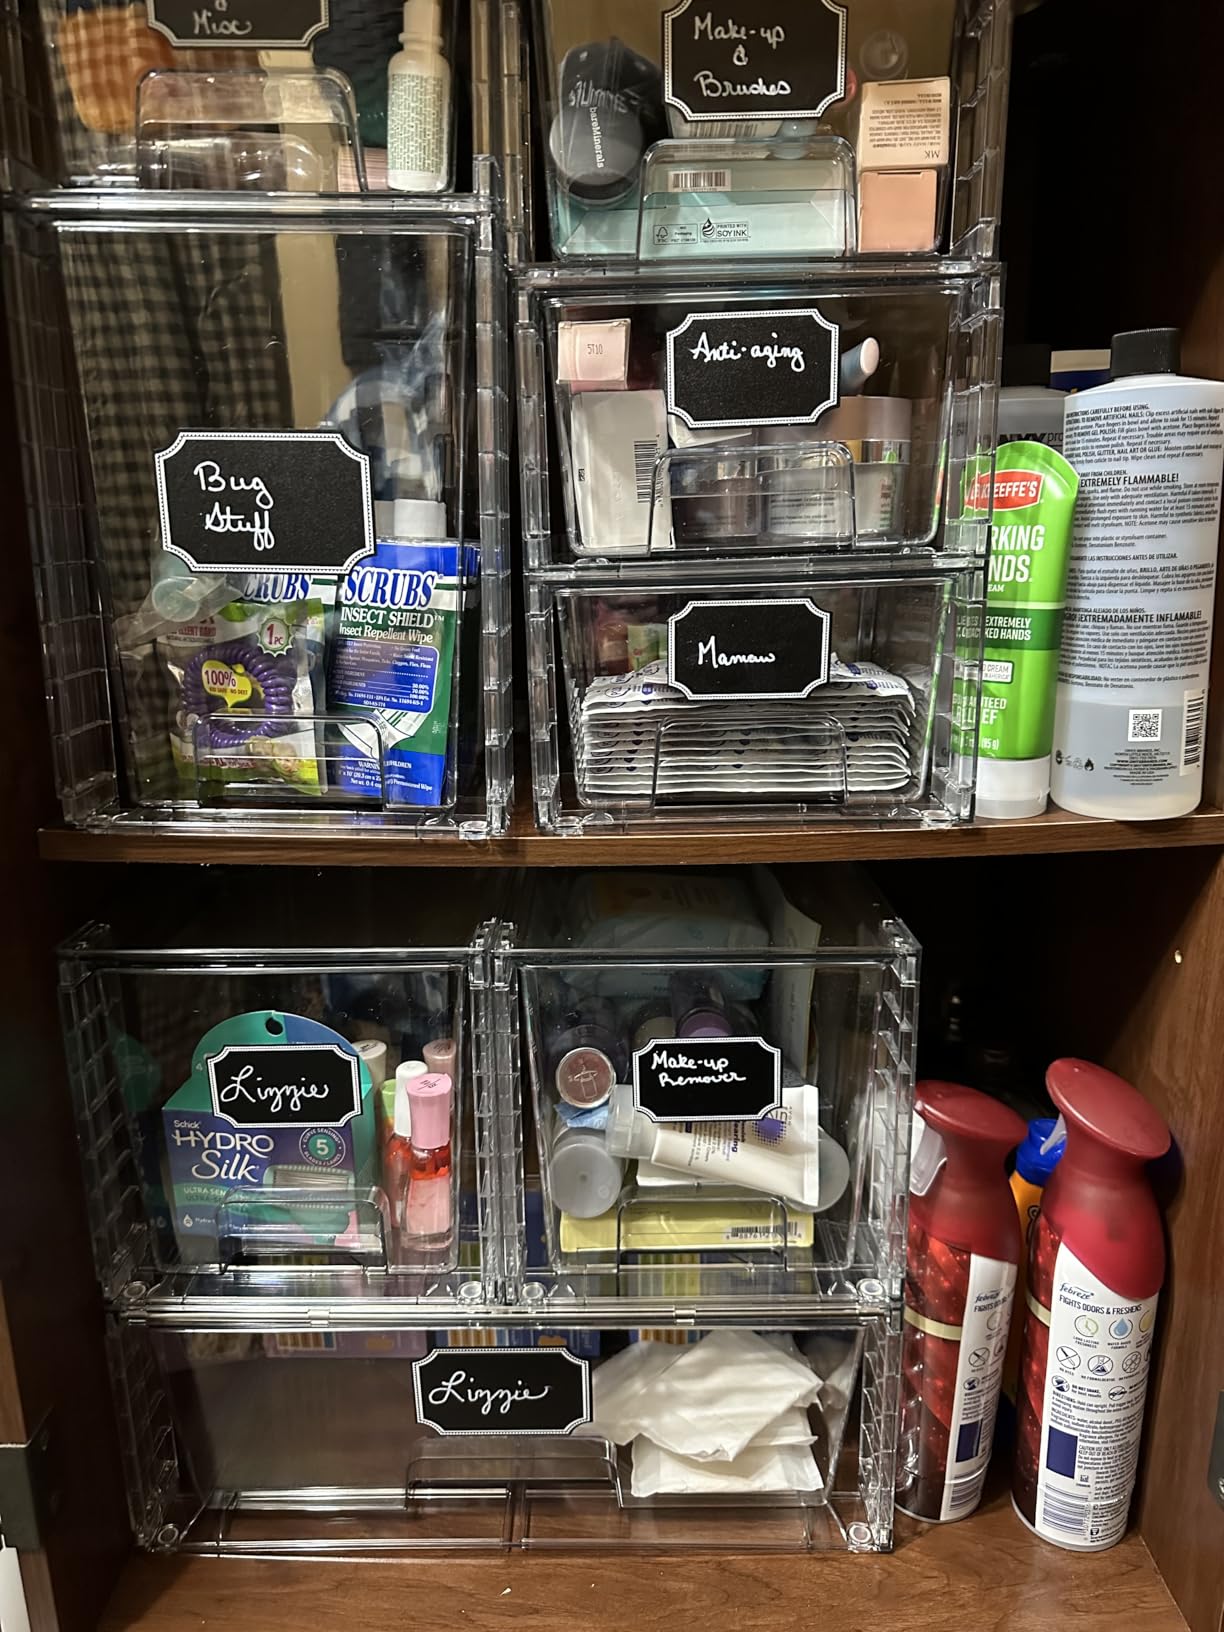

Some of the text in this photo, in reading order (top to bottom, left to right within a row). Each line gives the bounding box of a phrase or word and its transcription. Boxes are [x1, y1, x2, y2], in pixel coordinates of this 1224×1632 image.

[192, 8, 253, 36] Misc
[693, 11, 785, 50] Make-up
[692, 70, 792, 98] Brushes
[589, 106, 605, 169] bareMinerals
[717, 229, 748, 238] SOY INK
[689, 332, 807, 373] Anti-aging
[1090, 403, 1150, 415] CAREFULLY BEFORE USING.
[1103, 412, 1127, 421] ARTIFICIAL
[1080, 473, 1179, 488] EXTREMELY FLAMMABLE!
[1103, 469, 1128, 477] CHILDREN.
[193, 460, 274, 510] Bug
[203, 501, 275, 551] Stuff
[991, 525, 1046, 551] RKING
[344, 567, 436, 608] SCRUBS
[340, 607, 387, 624] INSECT
[985, 616, 1032, 629] EXTREMELY
[1156, 610, 1202, 622] INFLAMABLE!
[339, 622, 434, 645] Insect Repellent Wipe
[1000, 629, 1032, 641] HANDS
[988, 664, 1009, 673] CREAM
[204, 669, 237, 688] 100%
[358, 760, 381, 770] WARNIN
[651, 1050, 729, 1078] Make-up
[658, 1070, 746, 1088] Remover
[219, 1065, 331, 1113] Lizzie
[173, 1119, 200, 1129] Schick
[171, 1129, 275, 1159] HYDRO
[316, 1138, 329, 1156] 5
[191, 1149, 260, 1183] Silk
[183, 1186, 208, 1195] ULTRA
[1059, 1282, 1093, 1300] febreze
[1059, 1294, 1143, 1315] FIGHTS ODORS & FRESHENS
[426, 1370, 553, 1416] Lizzie
